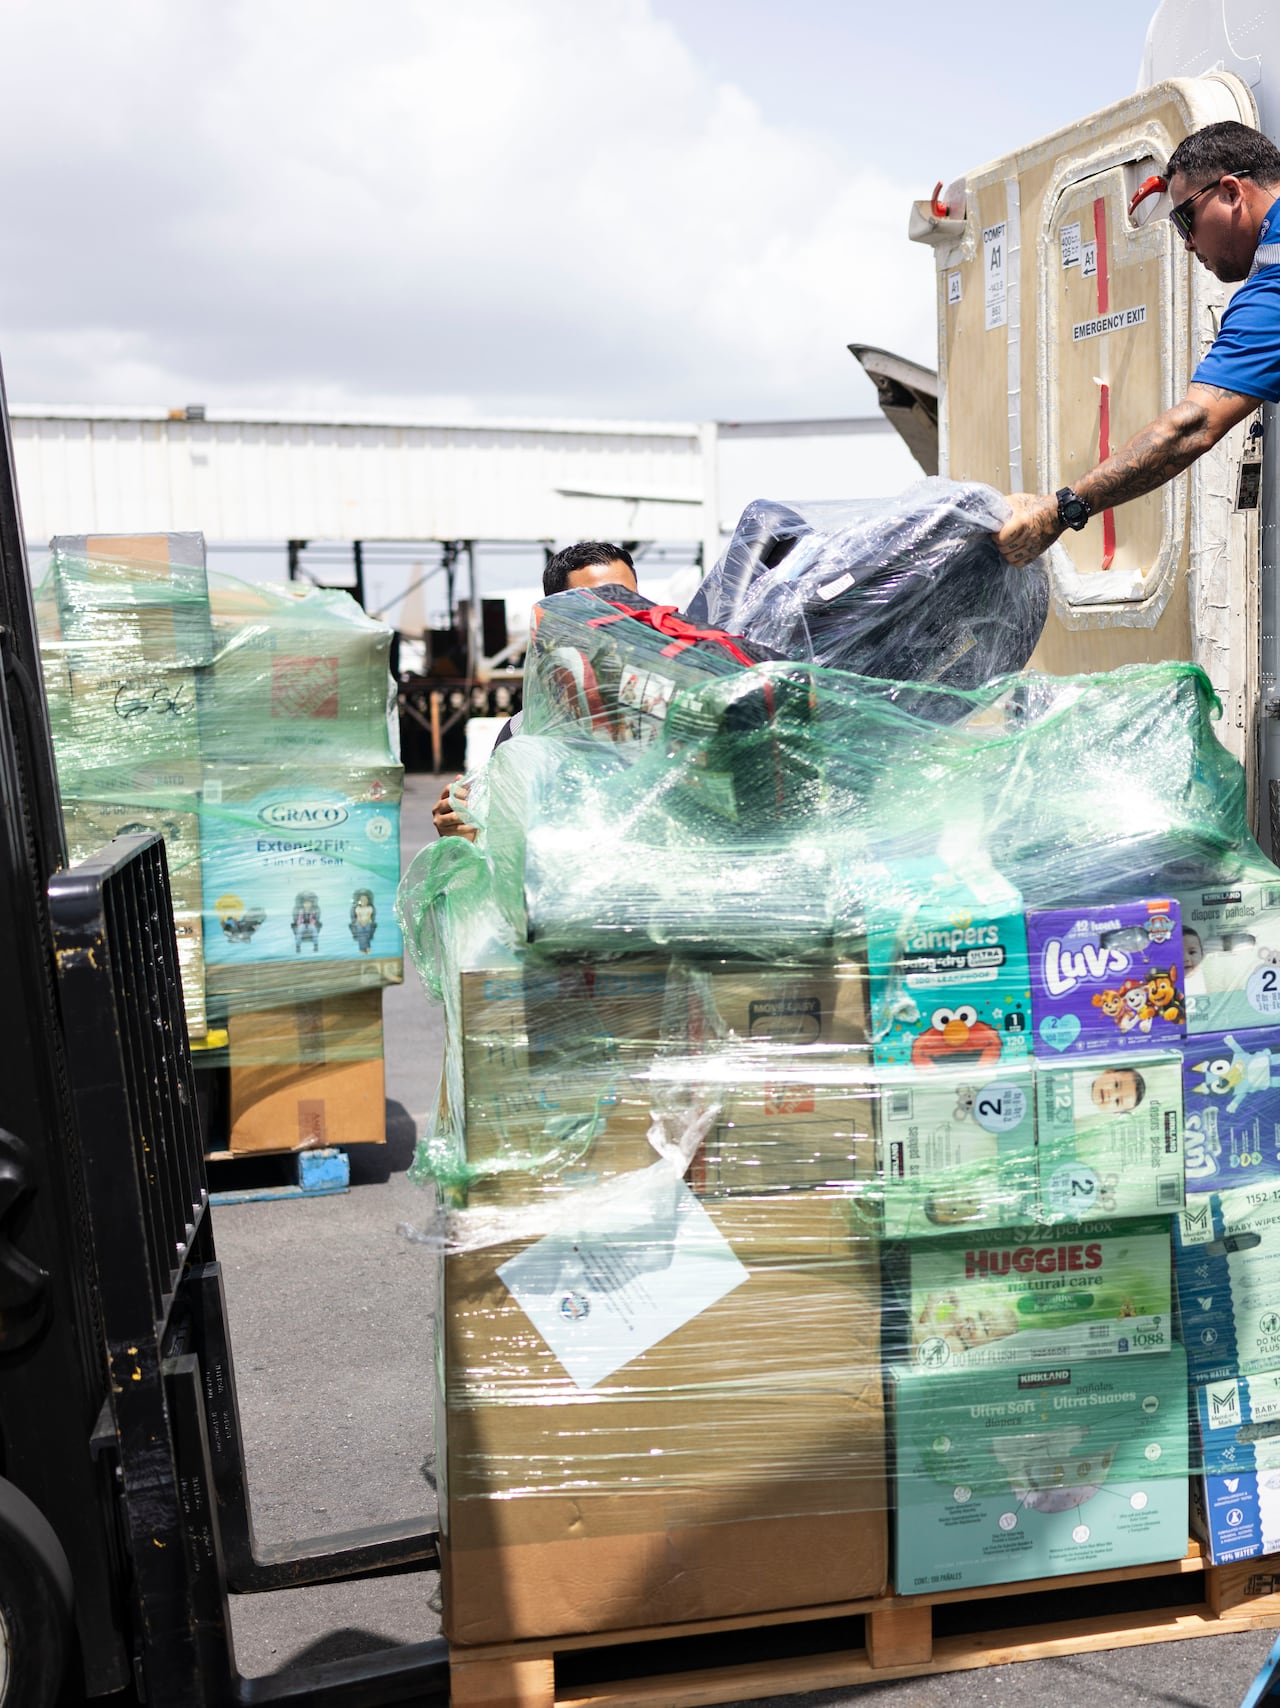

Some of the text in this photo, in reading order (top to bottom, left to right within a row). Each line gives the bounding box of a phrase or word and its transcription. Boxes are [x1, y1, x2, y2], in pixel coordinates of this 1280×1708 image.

[984, 225, 1006, 243] COMPT
[1074, 307, 1145, 339] EMERGENCY EXIT
[271, 806, 340, 823] GRACO
[1191, 909, 1220, 922] diapers
[904, 924, 999, 953] Pampers
[970, 949, 1000, 959] ULTRA
[1045, 940, 1130, 998] Luvs
[1261, 970, 1278, 992] 2
[978, 1098, 1002, 1116] 2
[1185, 1114, 1217, 1178] Luvs
[1072, 1179, 1094, 1197] 2
[1246, 1193, 1267, 1204] 1152
[1012, 1224, 1053, 1243] $22
[1056, 1222, 1079, 1239] per
[1084, 1220, 1113, 1233] box
[1228, 1223, 1252, 1233] BABY
[964, 1243, 1103, 1280] HUGGIES
[1007, 1275, 1103, 1292] natural care
[1132, 1333, 1164, 1346] 1088
[1256, 1338, 1268, 1346] DO
[1020, 1370, 1069, 1384] KIRKLAND
[1210, 1369, 1230, 1379] WATER
[1053, 1391, 1137, 1410] Ultra Suaves
[970, 1400, 1036, 1419] Ultra Soft
[1254, 1404, 1278, 1415] BABY
[1220, 1547, 1254, 1562] 99% WATER
